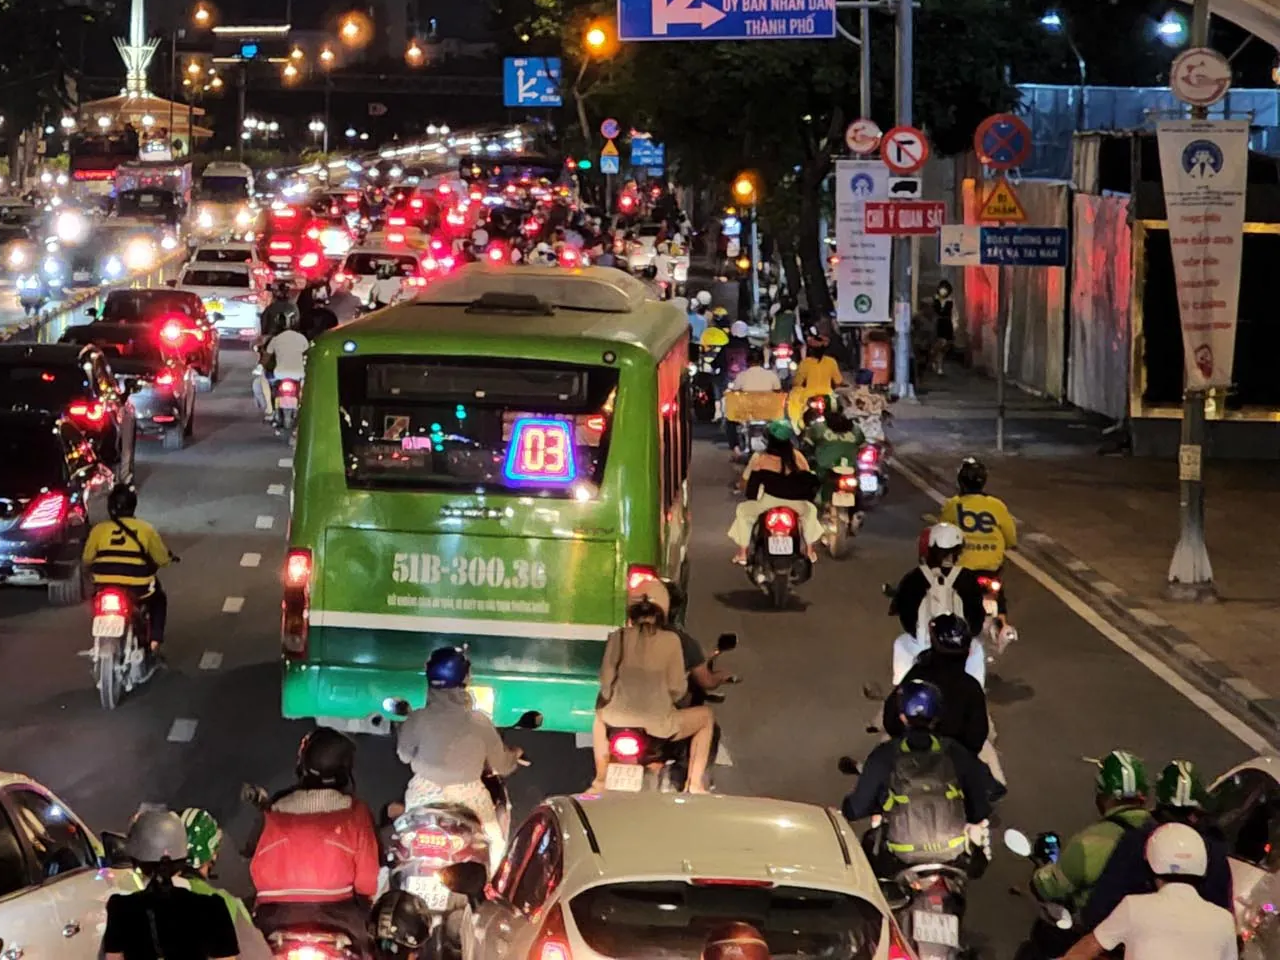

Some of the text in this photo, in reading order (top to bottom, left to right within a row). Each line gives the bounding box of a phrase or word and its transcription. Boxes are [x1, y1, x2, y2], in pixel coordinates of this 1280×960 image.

[744, 12, 816, 36] THÀNH PHỐ
[523, 428, 565, 472] 03
[956, 503, 997, 533] be
